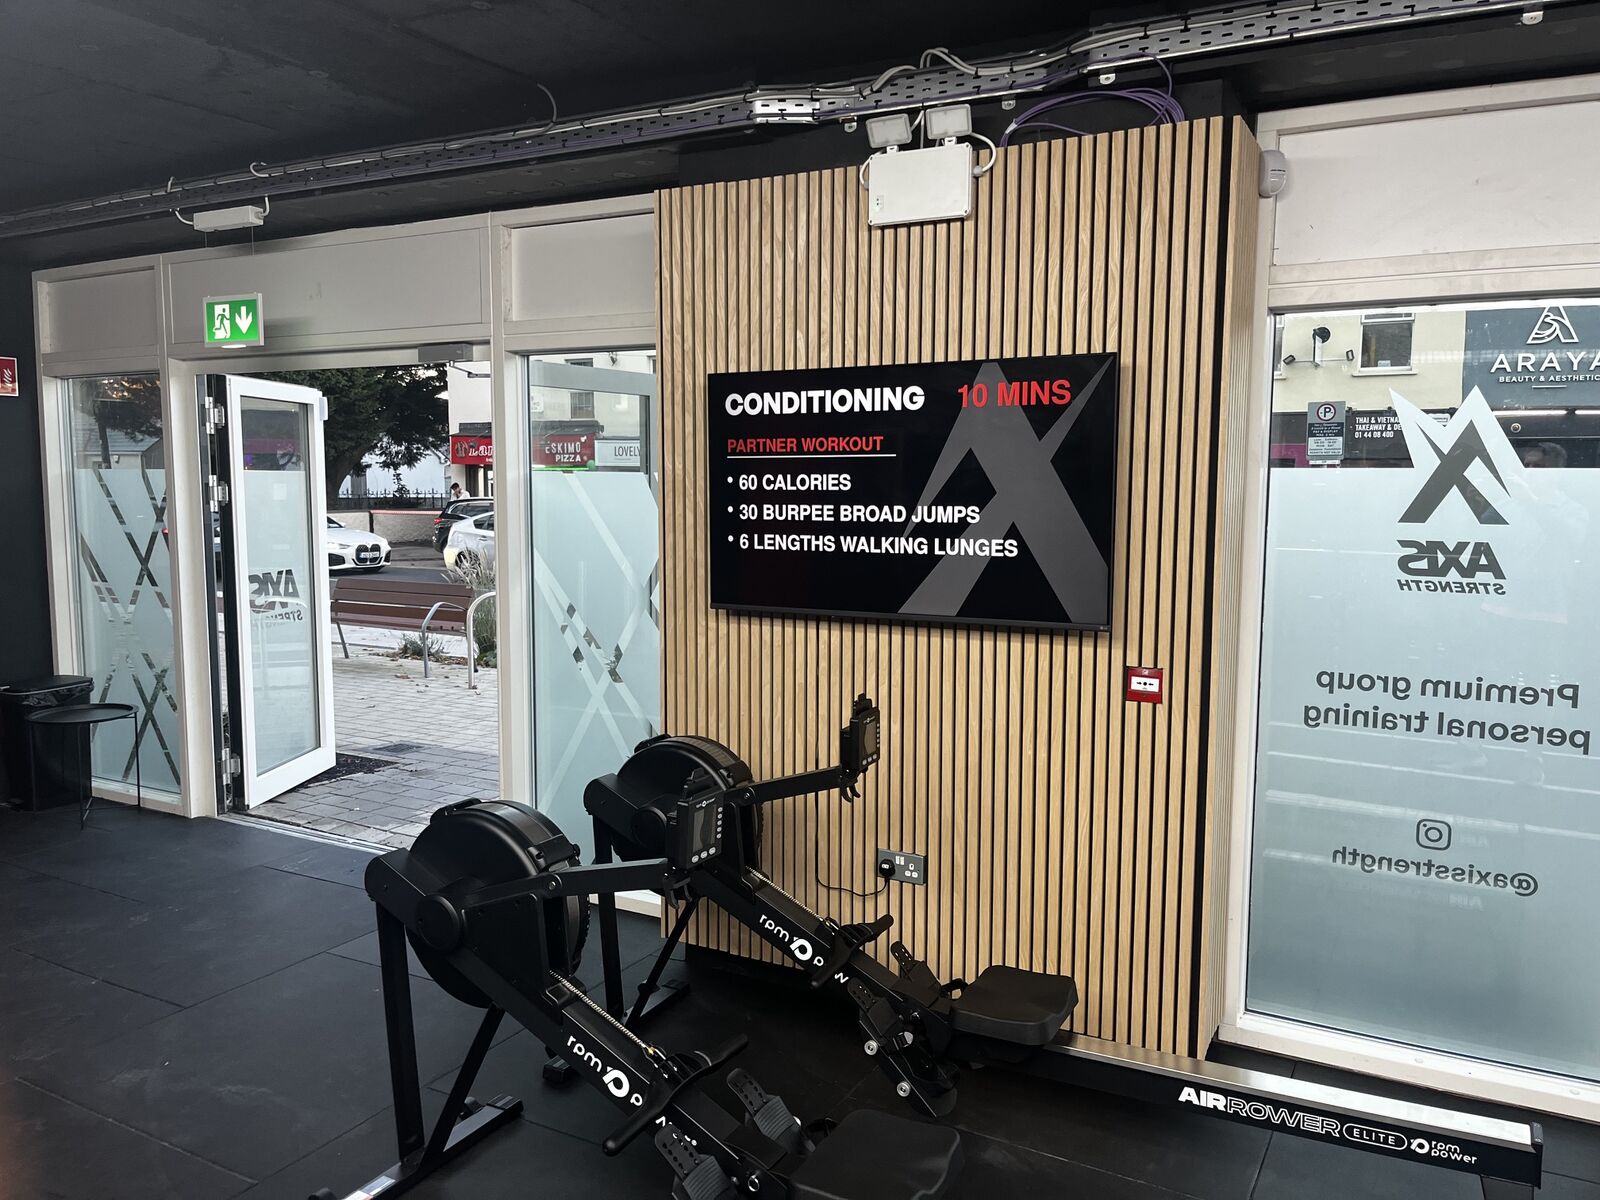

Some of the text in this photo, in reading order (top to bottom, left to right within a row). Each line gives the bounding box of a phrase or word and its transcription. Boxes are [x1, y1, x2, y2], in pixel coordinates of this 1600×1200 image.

[725, 379, 1072, 416] CONDITIONING 10 MINS
[1356, 416, 1369, 424] THAI
[1371, 416, 1376, 424] &
[727, 435, 884, 454] PARTNER WORKOUT
[555, 454, 582, 462] PIZZA
[739, 473, 852, 491] 60 CALORIES
[739, 504, 981, 524] 30 BURPEE BROAD JUMPS
[739, 534, 1019, 557] 6 LENGTHS WALKING LUNGES
[759, 914, 790, 943] rpm
[566, 1035, 603, 1073] rpm
[1353, 1128, 1397, 1146] ELITE
[1430, 1140, 1460, 1154] rpm
[1430, 1148, 1478, 1165] power
